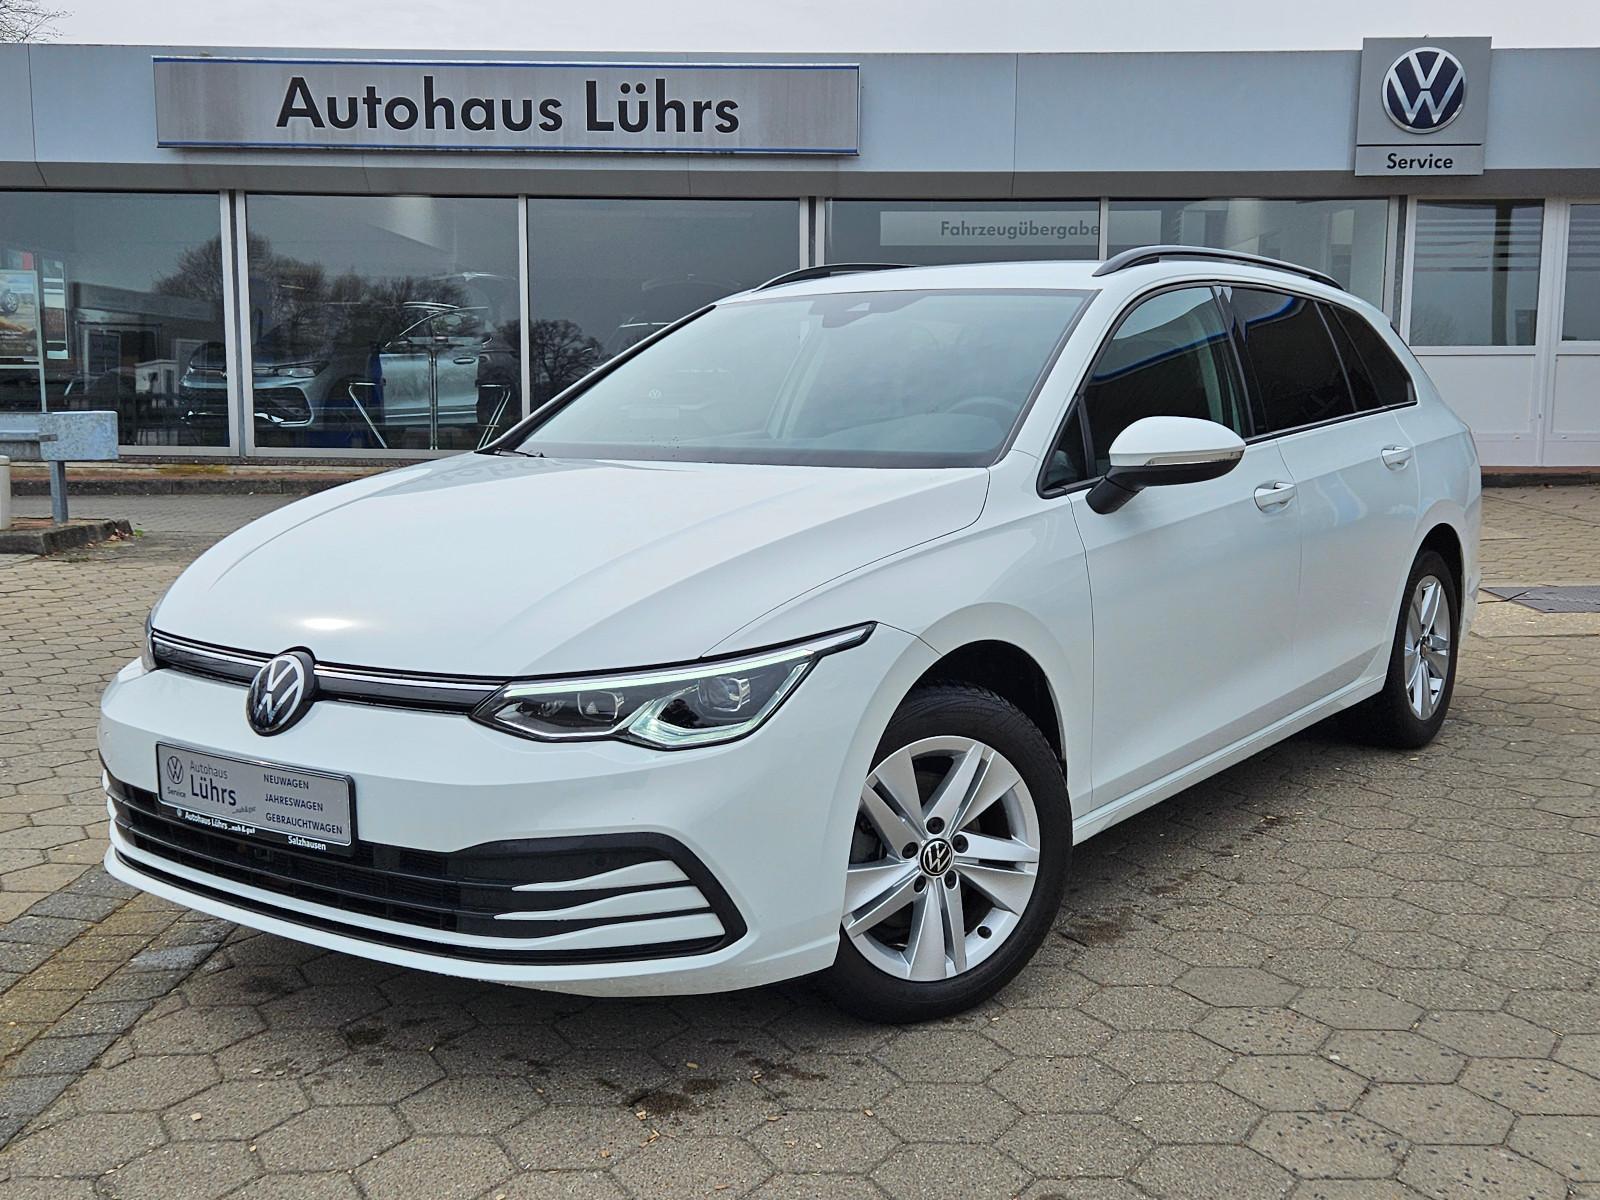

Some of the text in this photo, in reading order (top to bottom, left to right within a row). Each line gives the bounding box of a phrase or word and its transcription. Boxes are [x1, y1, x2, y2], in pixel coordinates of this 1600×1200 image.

[277, 75, 739, 134] Autohaus Lührs
[1386, 152, 1453, 169] Service
[940, 220, 1099, 239] Fahrzeugübergabe
[190, 760, 228, 780] Autohaus
[190, 774, 237, 807] Lührs
[263, 773, 309, 790] NEUWAGEN
[167, 786, 186, 798] Service
[265, 793, 324, 812] JAHRESWAGEN
[184, 811, 211, 826] Autohaus
[211, 818, 228, 830] Lührs
[265, 812, 343, 835] GEBRAUCHTWAGEN
[287, 835, 327, 851] Salzhausen
